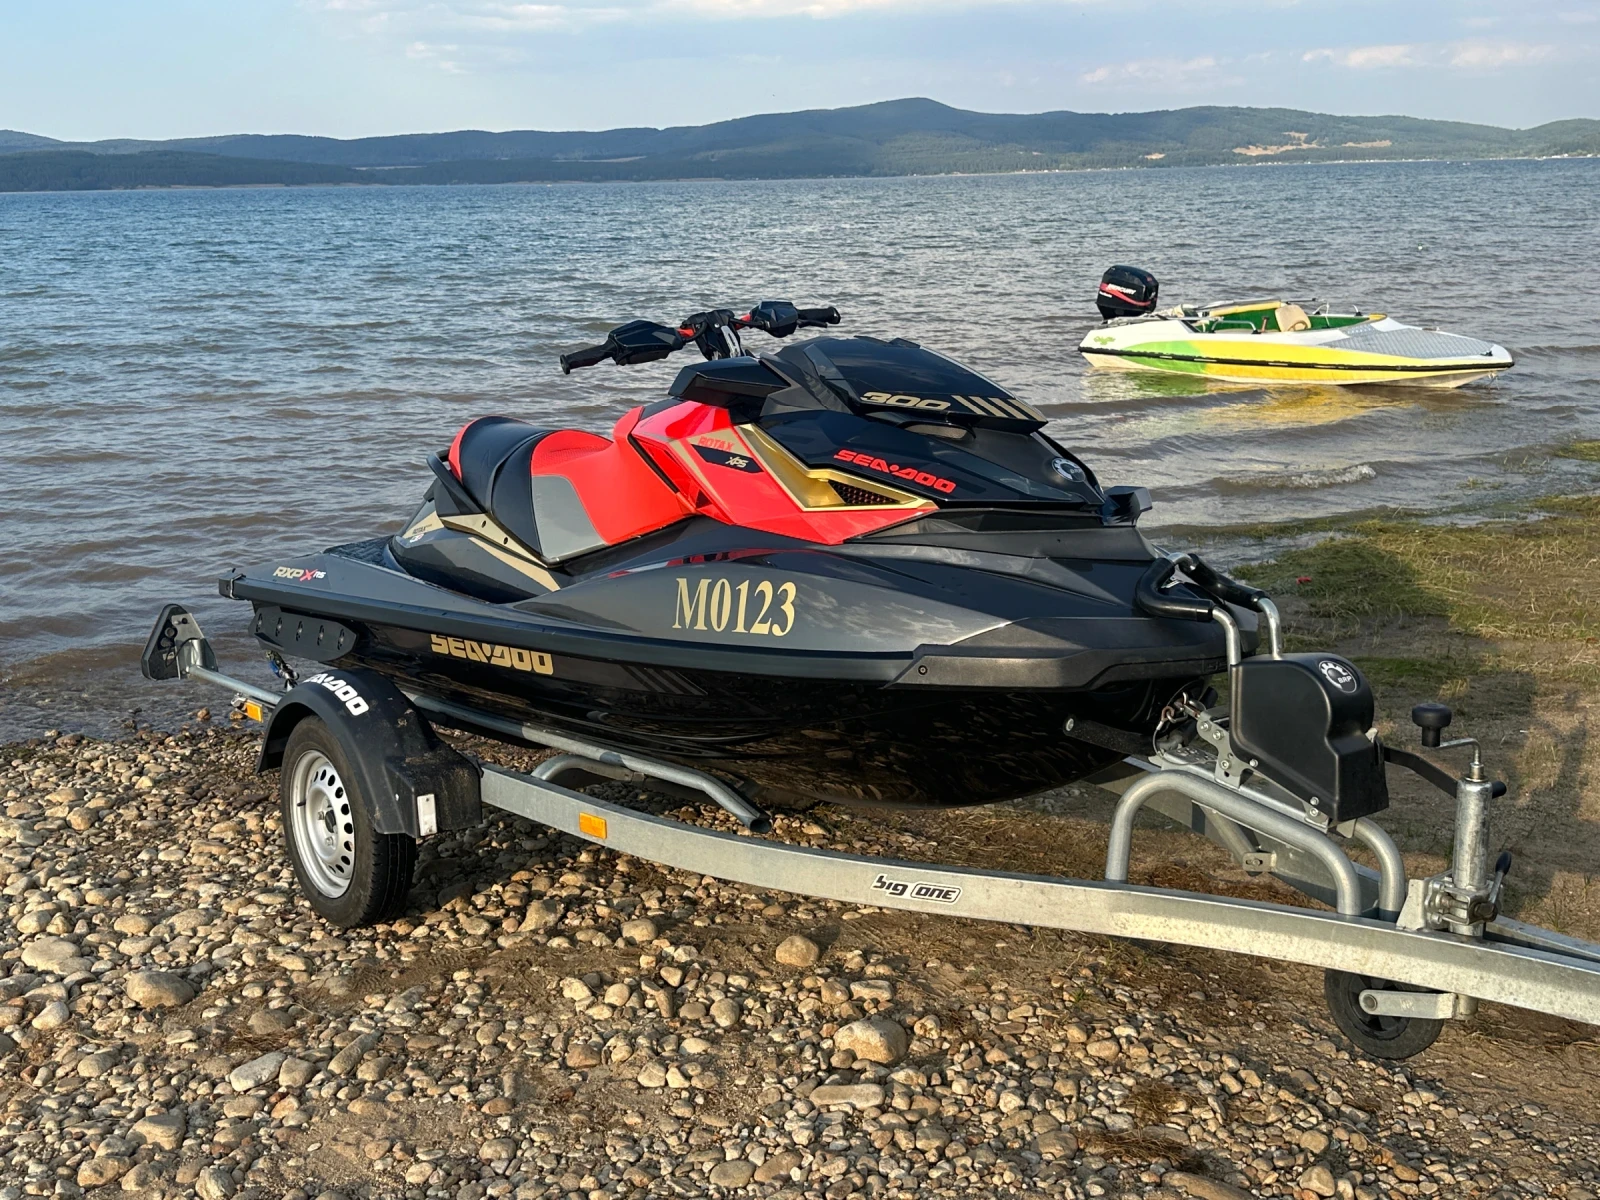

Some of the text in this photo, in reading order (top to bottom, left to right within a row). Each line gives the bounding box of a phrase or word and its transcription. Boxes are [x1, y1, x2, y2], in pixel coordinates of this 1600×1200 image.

[860, 392, 951, 410] 300
[698, 436, 734, 452] ROTAX
[725, 456, 749, 468] XPS
[272, 566, 304, 579] RXP
[672, 577, 797, 637] M0123
[1337, 675, 1352, 684] BRP
[873, 875, 909, 896] big
